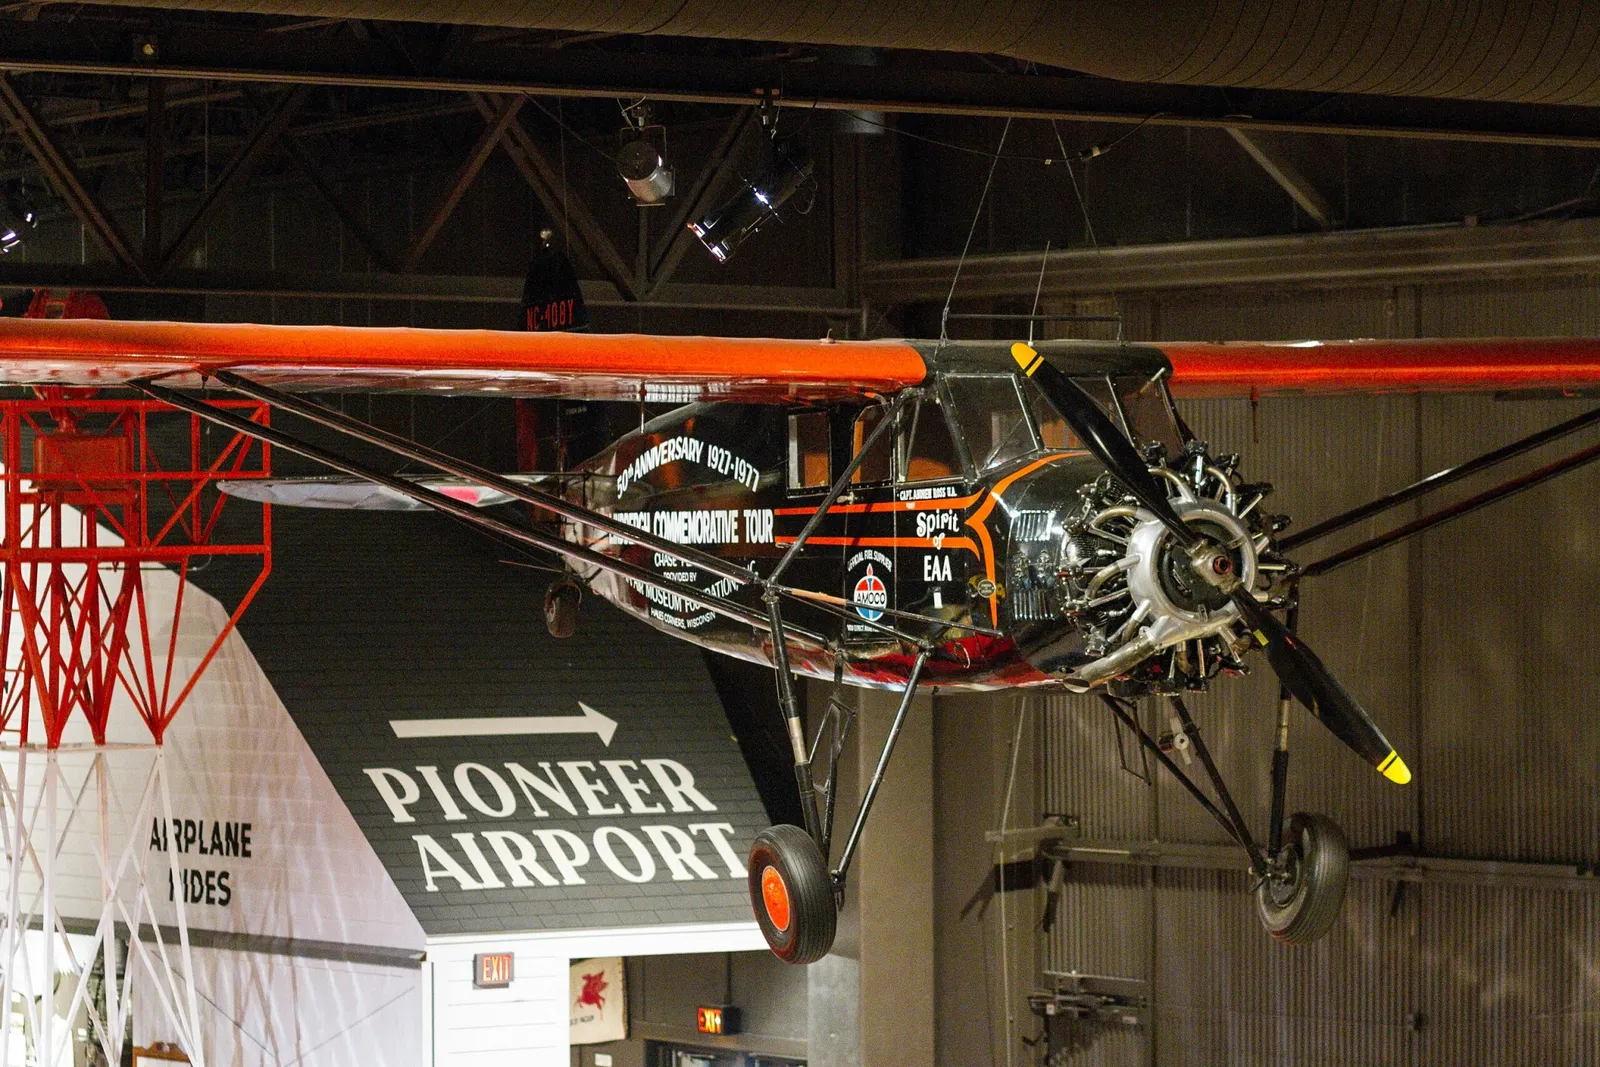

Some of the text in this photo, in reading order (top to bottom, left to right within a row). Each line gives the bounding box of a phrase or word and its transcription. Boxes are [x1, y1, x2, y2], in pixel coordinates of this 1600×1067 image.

[634, 436, 704, 482] ANNIVERSARY
[653, 509, 739, 545] COMMEMORATIVE
[743, 508, 774, 544] TOUR
[916, 508, 960, 540] Spirit
[932, 532, 946, 550] of
[654, 552, 678, 568] CHASE
[923, 555, 953, 581] EAA
[663, 571, 697, 583] PROVIDED BY
[645, 584, 682, 612] MUSEUM
[856, 592, 886, 605] AMOCO
[686, 611, 717, 628] WISCONSIN
[363, 757, 718, 823] PIONEER
[149, 816, 252, 858] AIRPLANE
[412, 822, 749, 892] AIRPORT
[482, 954, 512, 982] EXIT
[697, 1007, 722, 1034] EXIT
